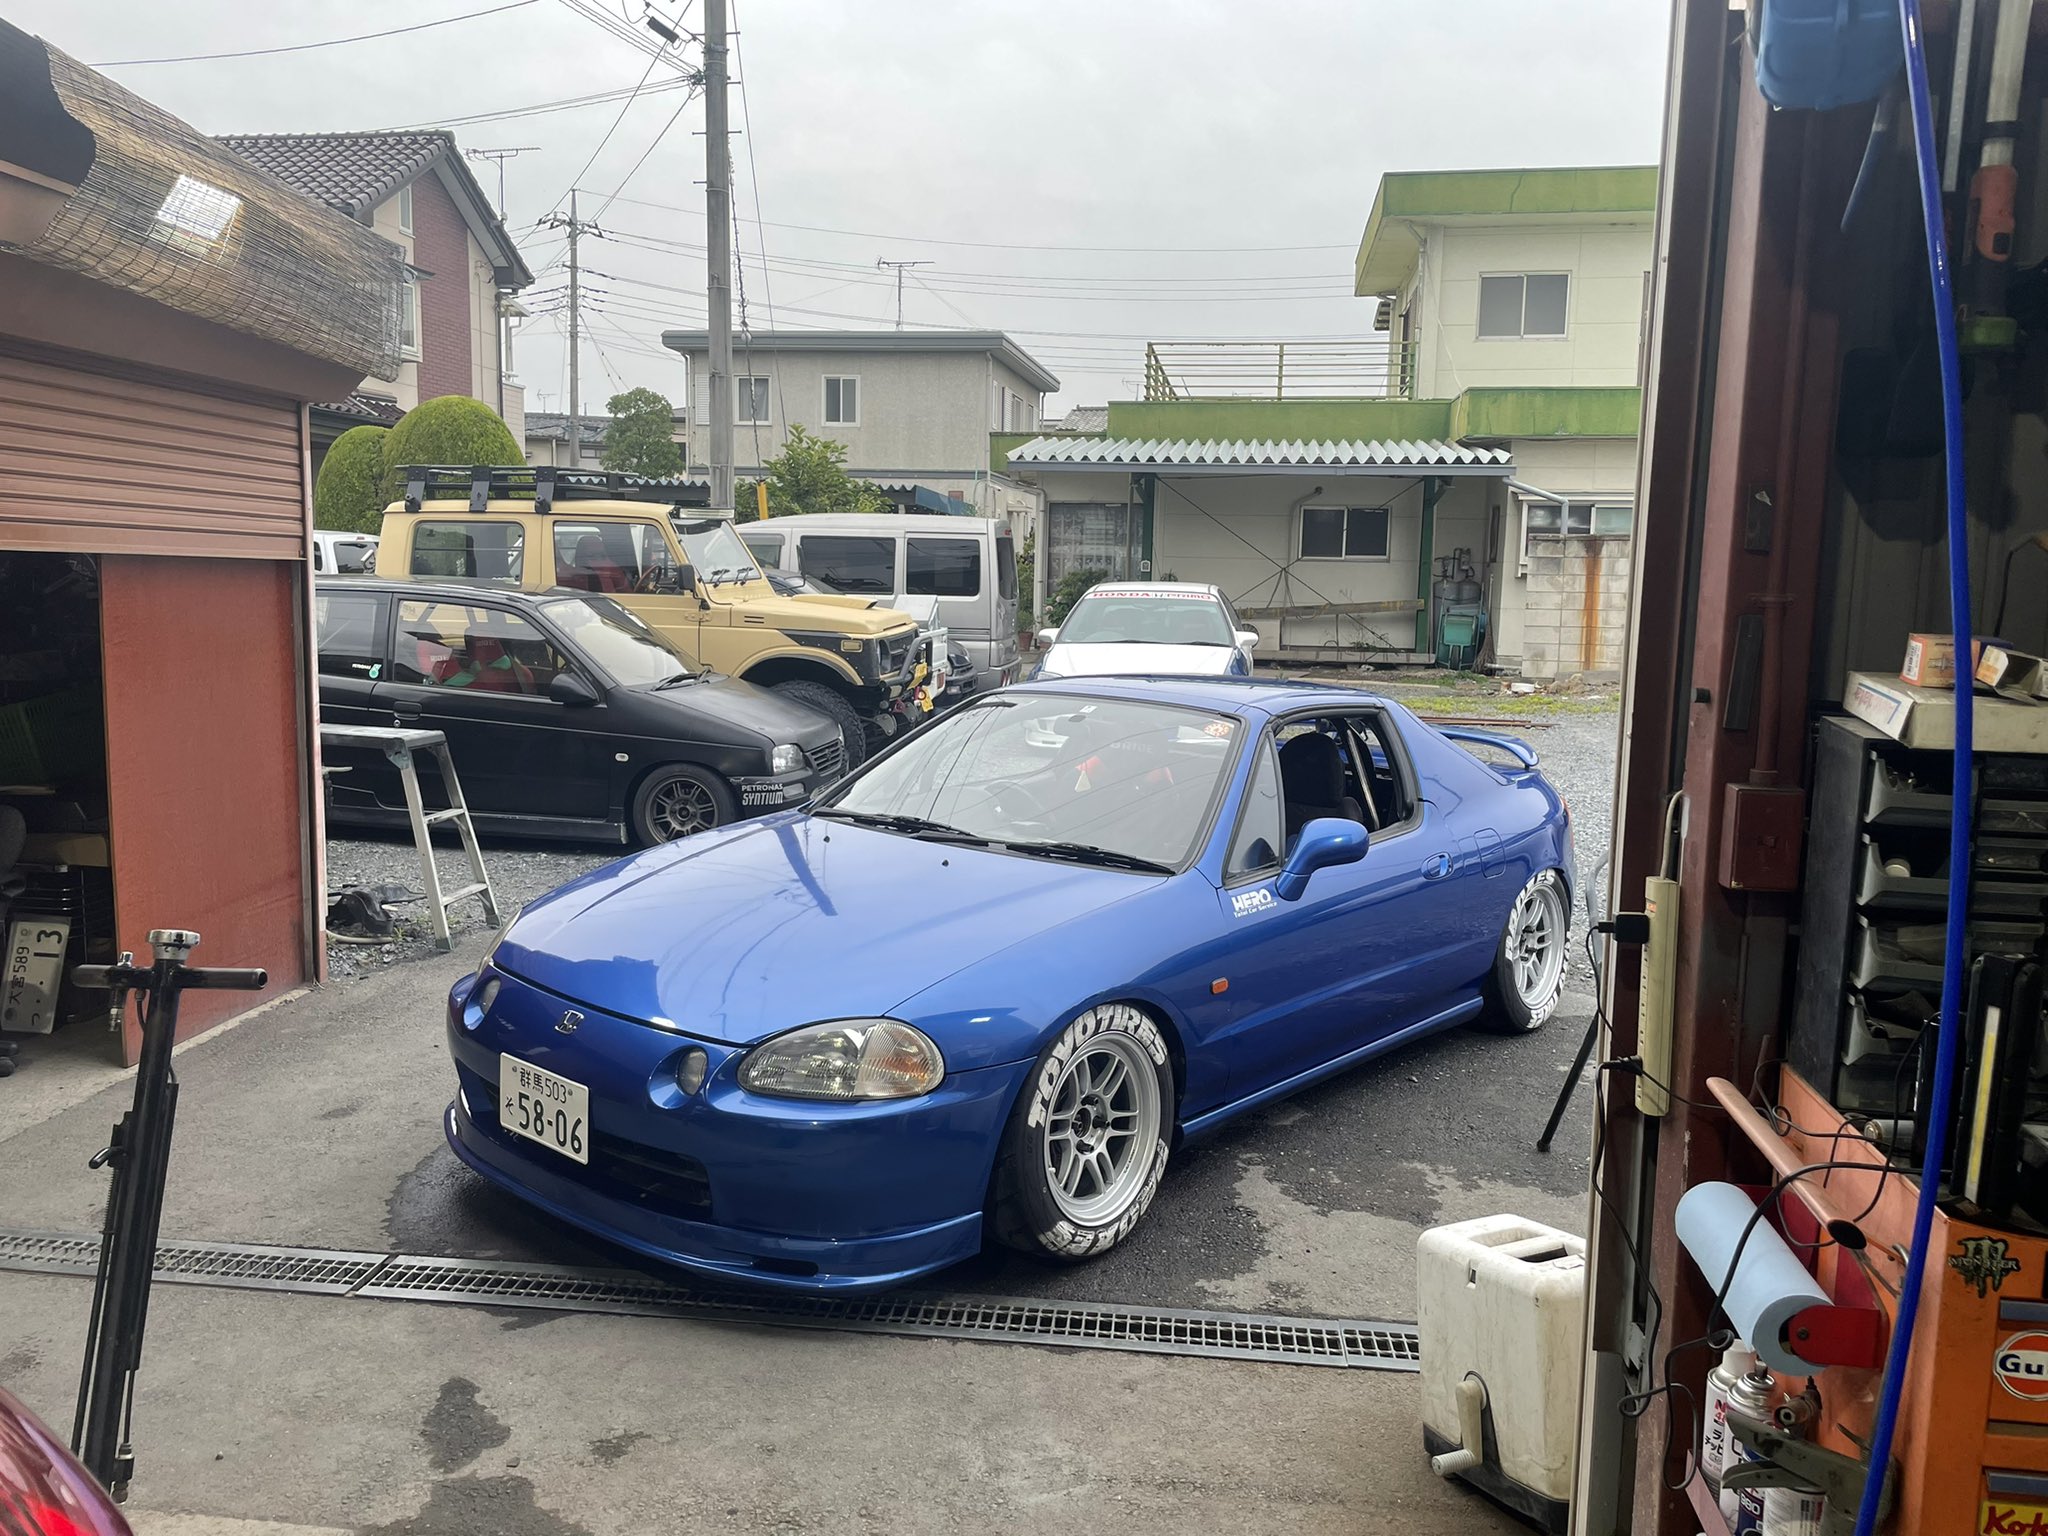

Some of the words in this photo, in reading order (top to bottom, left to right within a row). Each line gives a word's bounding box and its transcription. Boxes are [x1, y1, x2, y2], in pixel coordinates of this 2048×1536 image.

[741, 783, 784, 791] PETRONAS
[742, 791, 783, 806] SYNTIUM
[1231, 888, 1272, 912] HERO
[1258, 902, 1277, 911] Service
[505, 1096, 515, 1116] そ
[518, 1091, 582, 1154] 58-06
[1947, 1256, 2018, 1271] MONSTER
